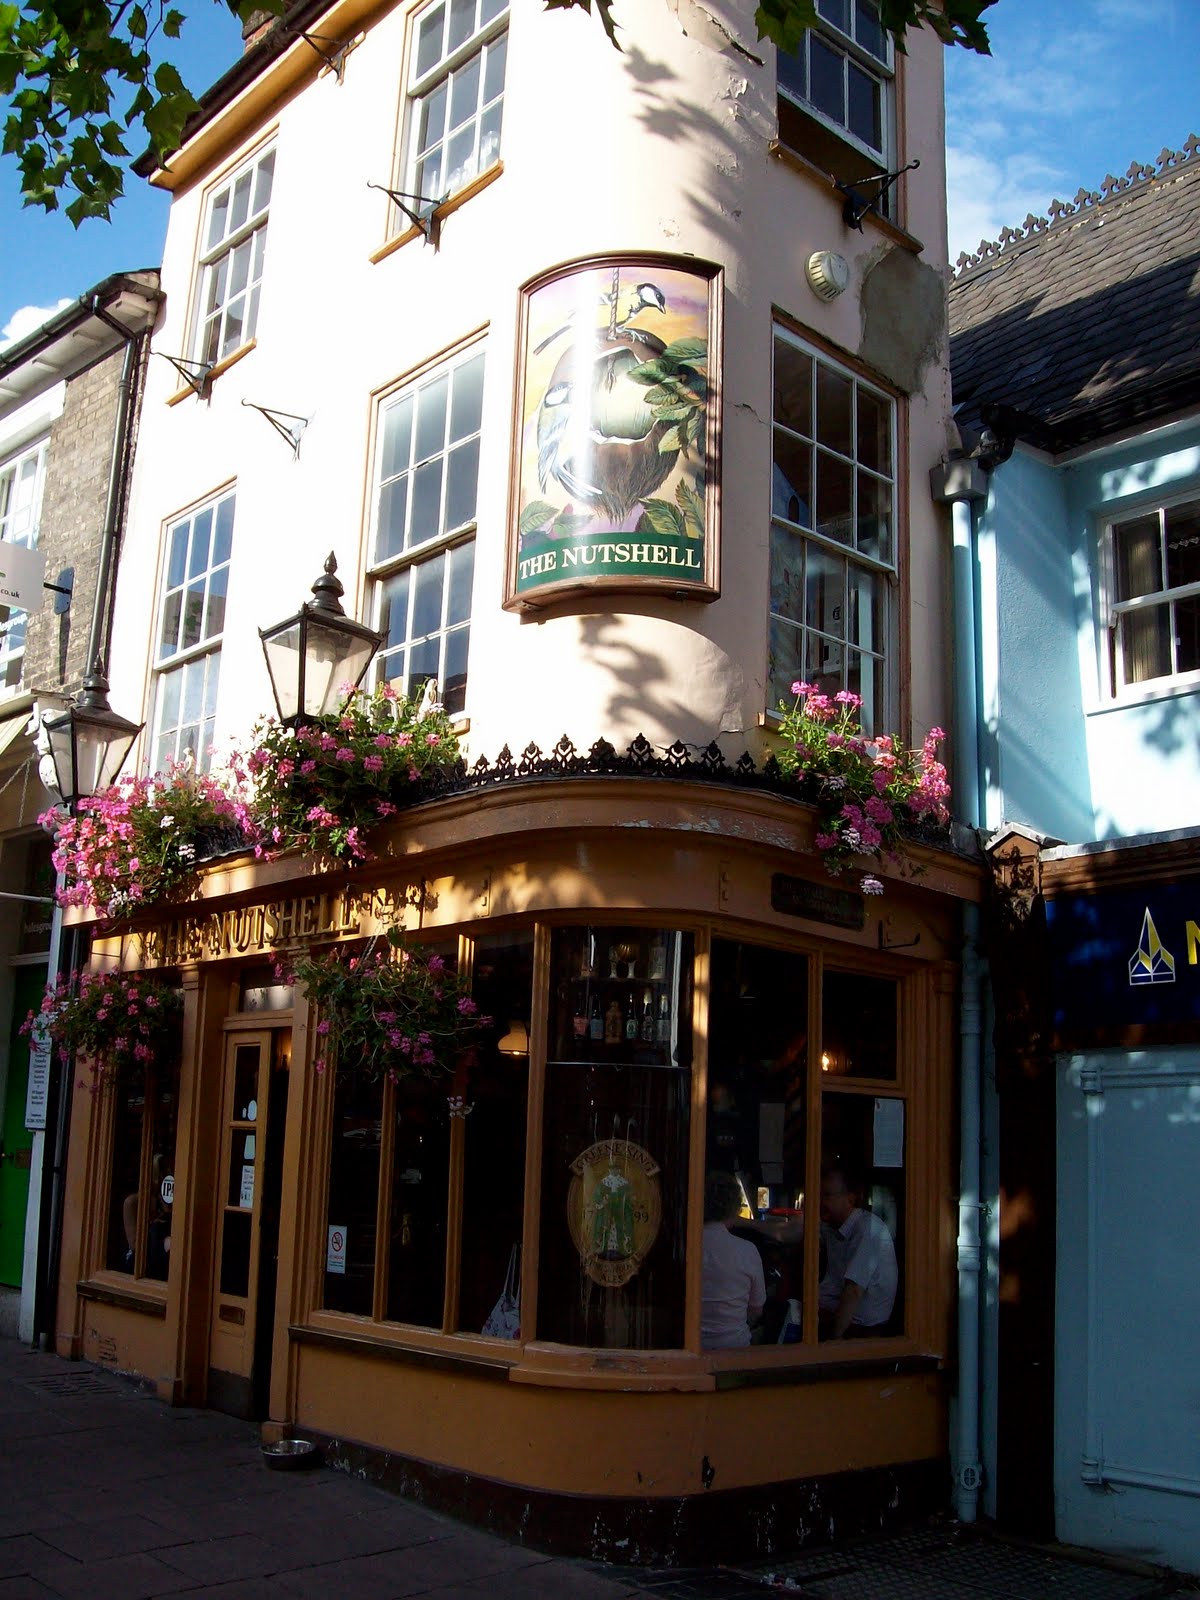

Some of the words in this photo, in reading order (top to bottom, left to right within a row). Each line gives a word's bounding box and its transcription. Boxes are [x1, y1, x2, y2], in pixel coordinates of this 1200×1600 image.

[519, 551, 557, 580] THE
[562, 543, 701, 569] NUTSHELL
[209, 889, 359, 952] NUTSHELL
